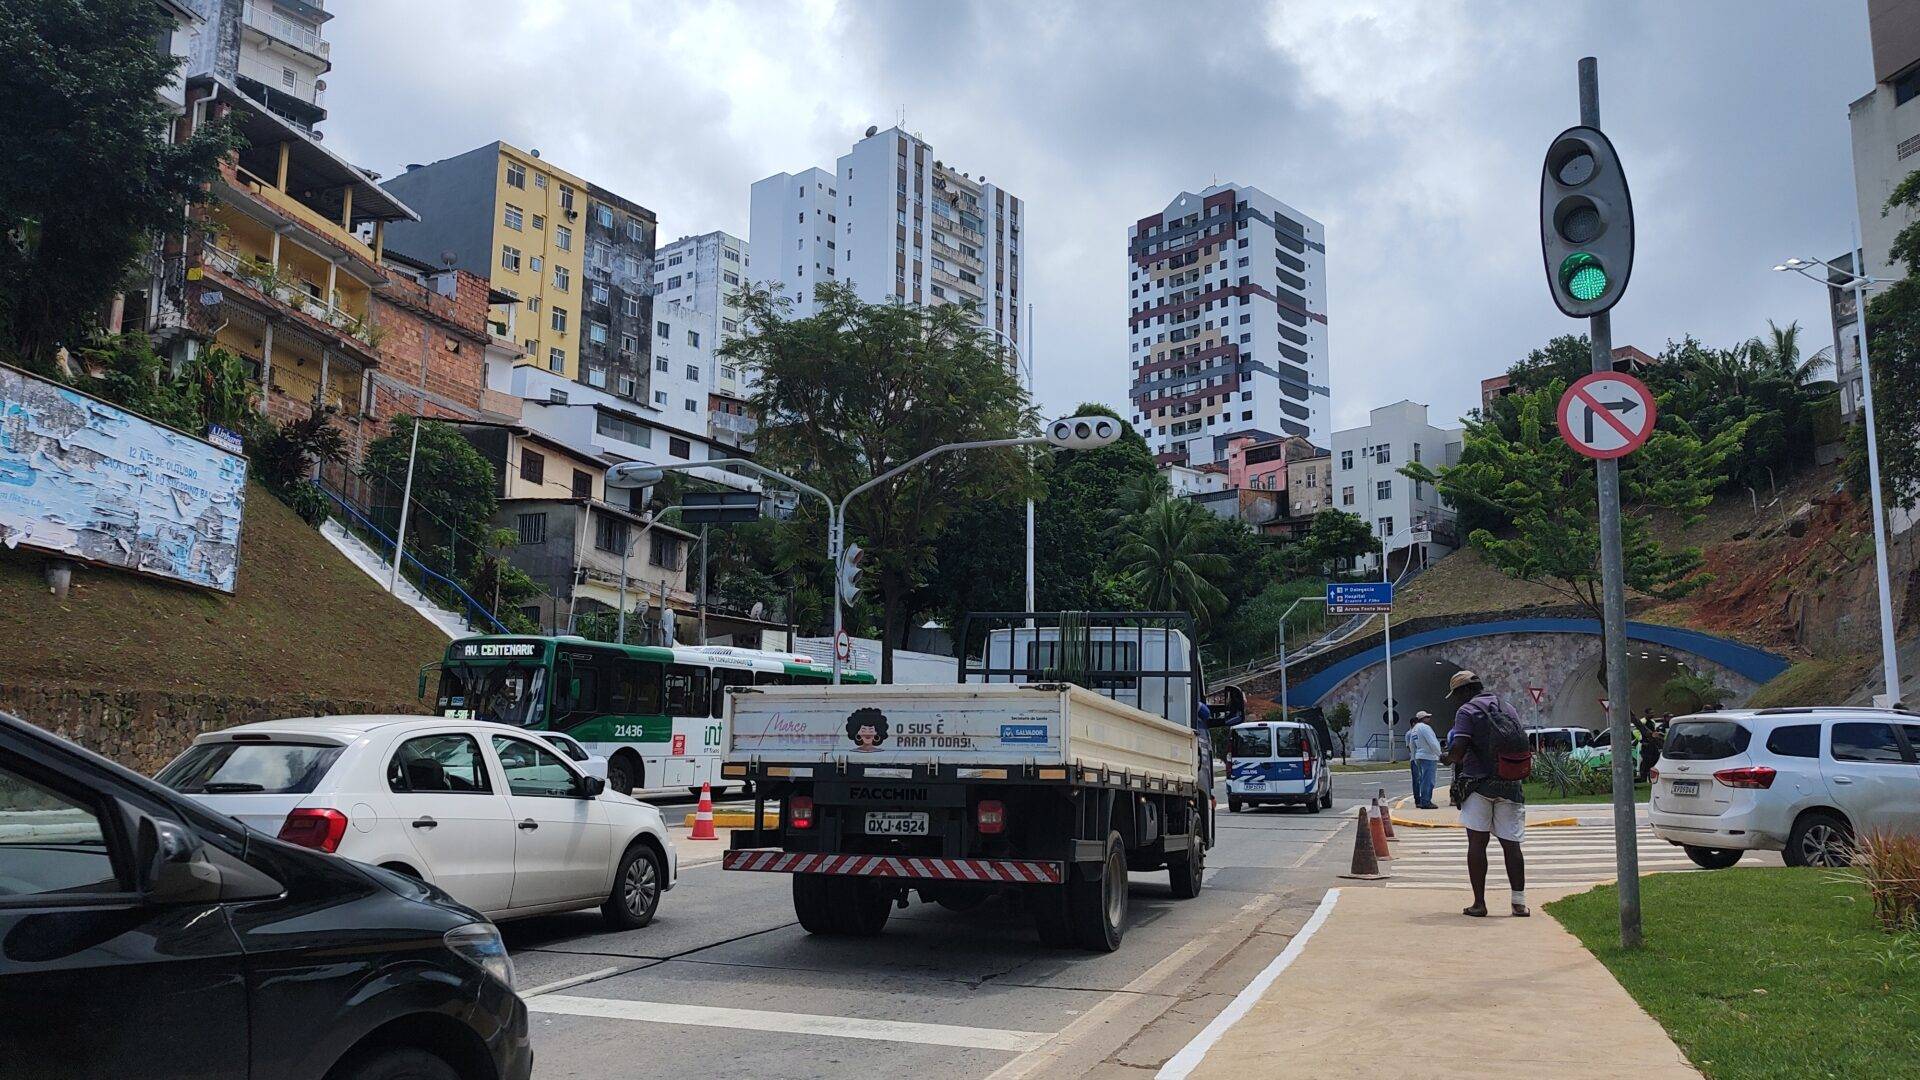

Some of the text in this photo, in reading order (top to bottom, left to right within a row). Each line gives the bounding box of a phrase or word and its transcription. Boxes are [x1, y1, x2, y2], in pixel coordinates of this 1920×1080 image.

[614, 725, 643, 737] 21436
[896, 718, 944, 734] O SUS É
[896, 736, 971, 748] PARA TODAS!
[849, 786, 928, 801] FACCHINI
